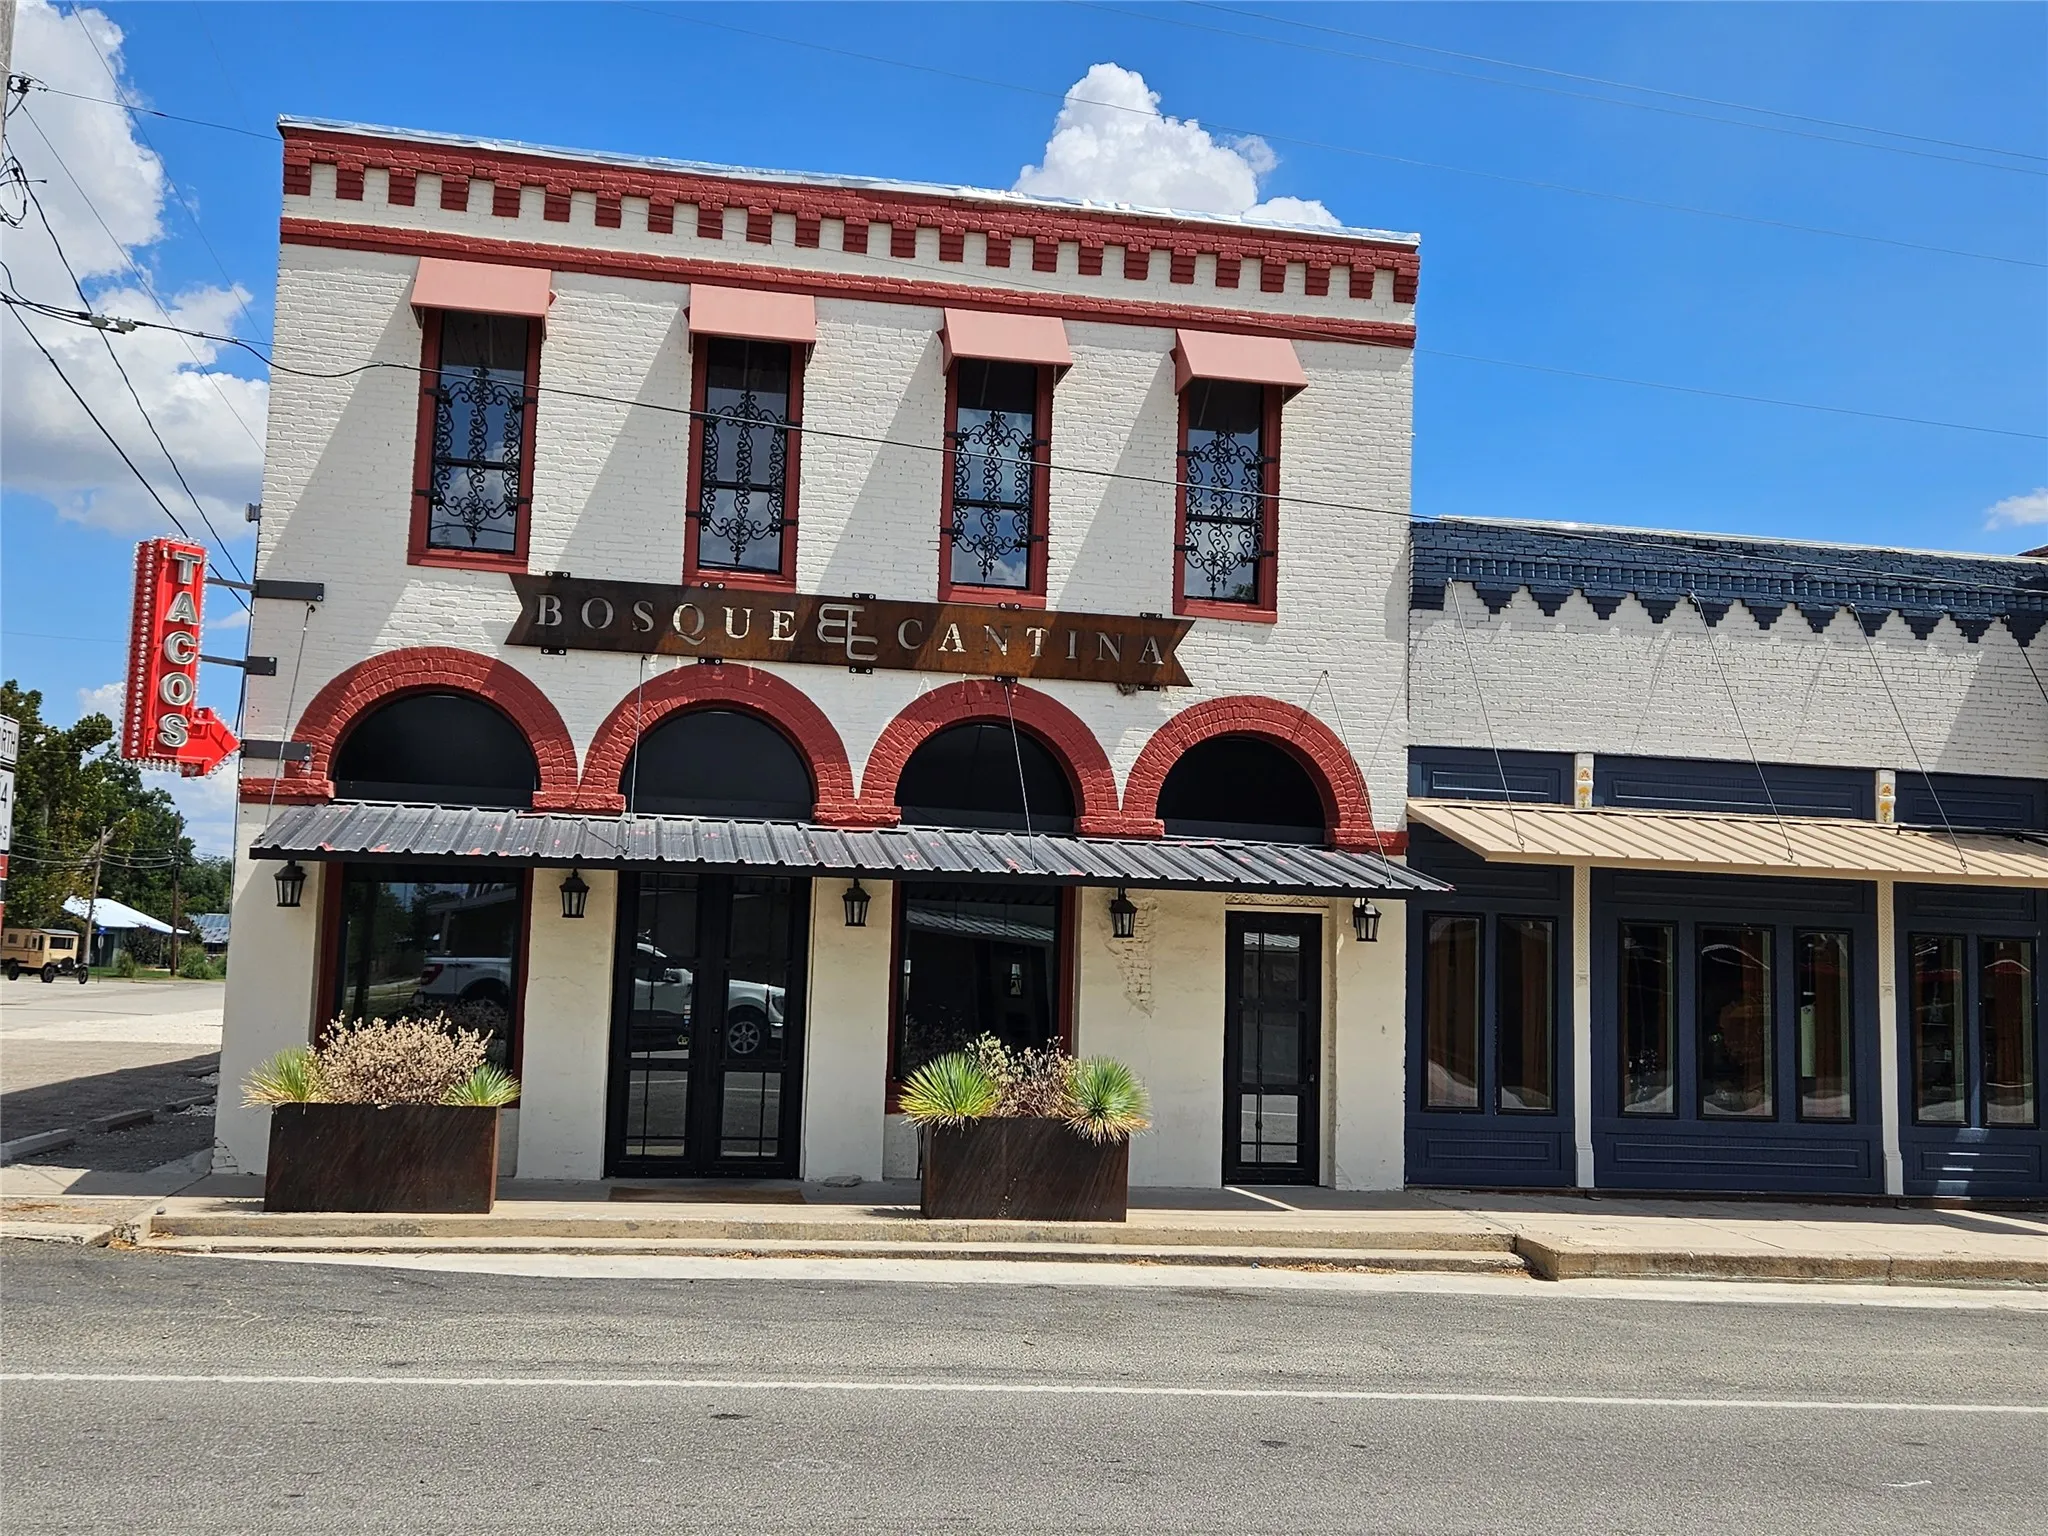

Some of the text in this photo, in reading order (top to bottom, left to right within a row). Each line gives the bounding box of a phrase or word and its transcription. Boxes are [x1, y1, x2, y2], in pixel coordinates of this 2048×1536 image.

[157, 551, 202, 748] TACOS
[535, 593, 798, 645] BOSQUE
[897, 618, 1165, 665] CANTINA
[0, 727, 16, 755] RTH
